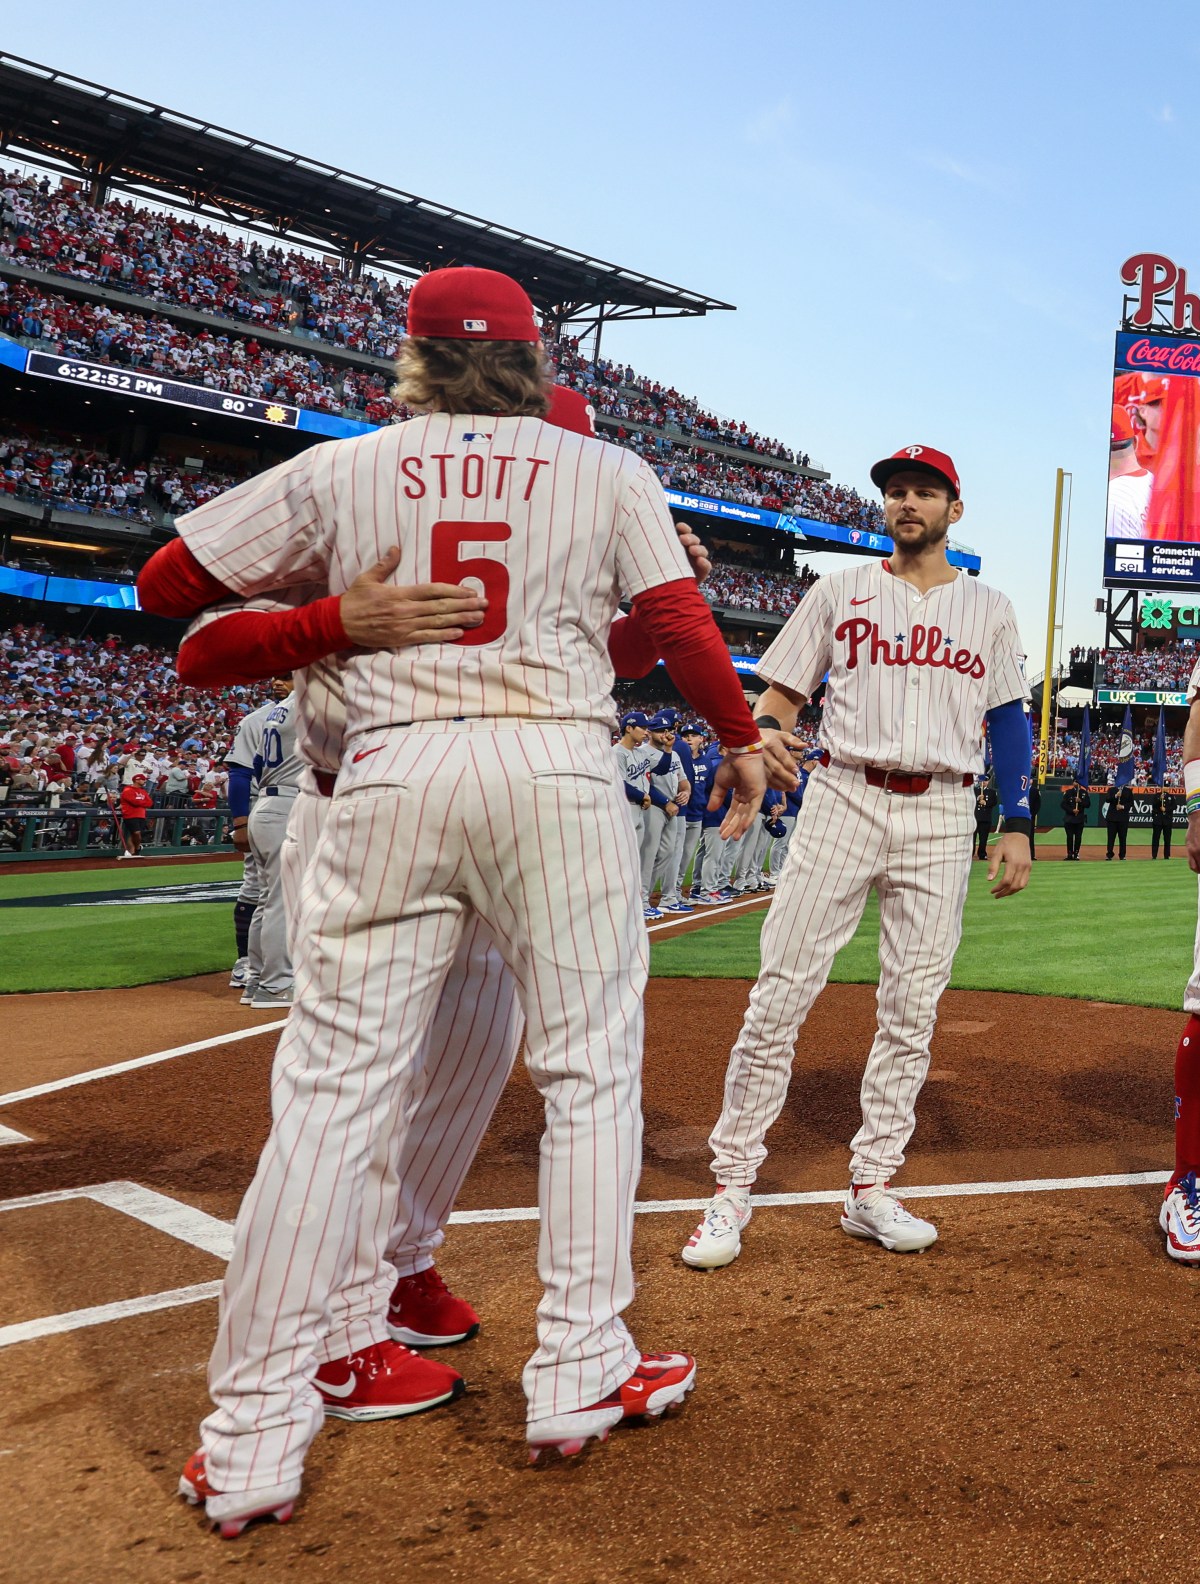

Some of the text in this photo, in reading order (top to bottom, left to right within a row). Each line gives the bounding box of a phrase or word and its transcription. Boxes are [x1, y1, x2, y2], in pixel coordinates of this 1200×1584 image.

[57, 363, 163, 396] 6:22:52 PM
[905, 445, 923, 459] P
[400, 452, 550, 501] STOTT
[720, 505, 761, 520] Booking.com
[1152, 555, 1194, 566] financial
[1151, 567, 1194, 576] services.
[430, 520, 512, 647] 5
[834, 617, 986, 680] Phillies
[1110, 691, 1182, 704] UKG UKG
